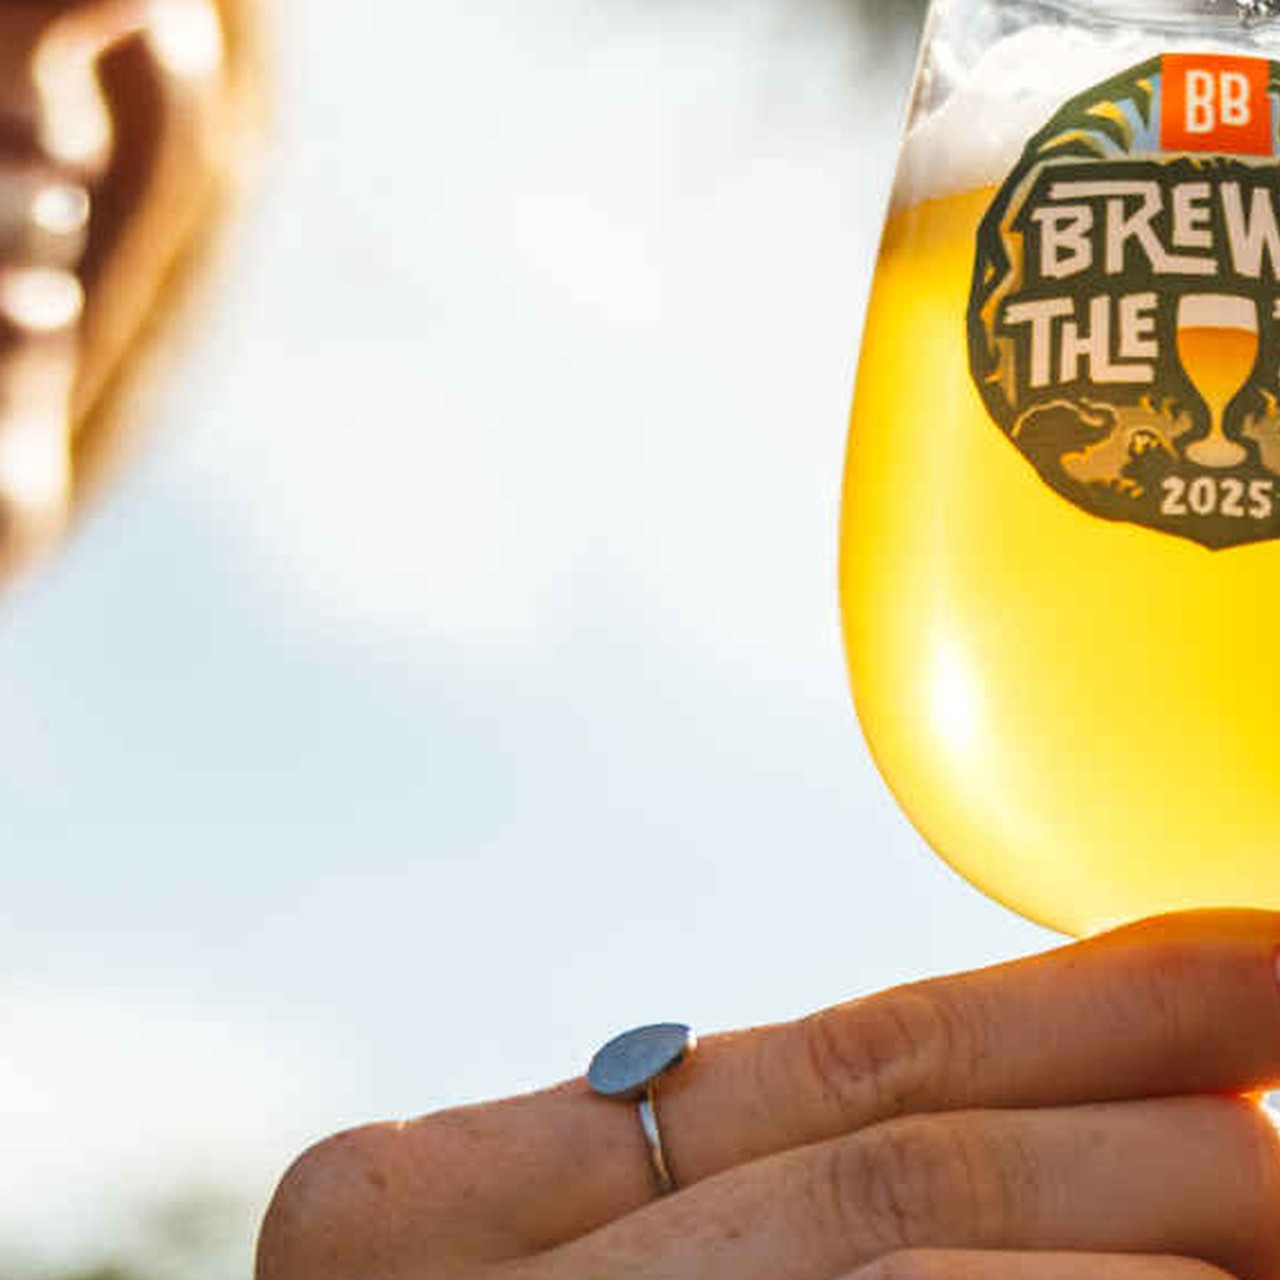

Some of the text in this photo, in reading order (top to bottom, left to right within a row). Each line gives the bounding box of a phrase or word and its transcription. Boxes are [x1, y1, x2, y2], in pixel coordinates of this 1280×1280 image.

[1184, 69, 1250, 133] BB
[1003, 292, 1159, 388] THE
[1160, 477, 1274, 519] 2025
